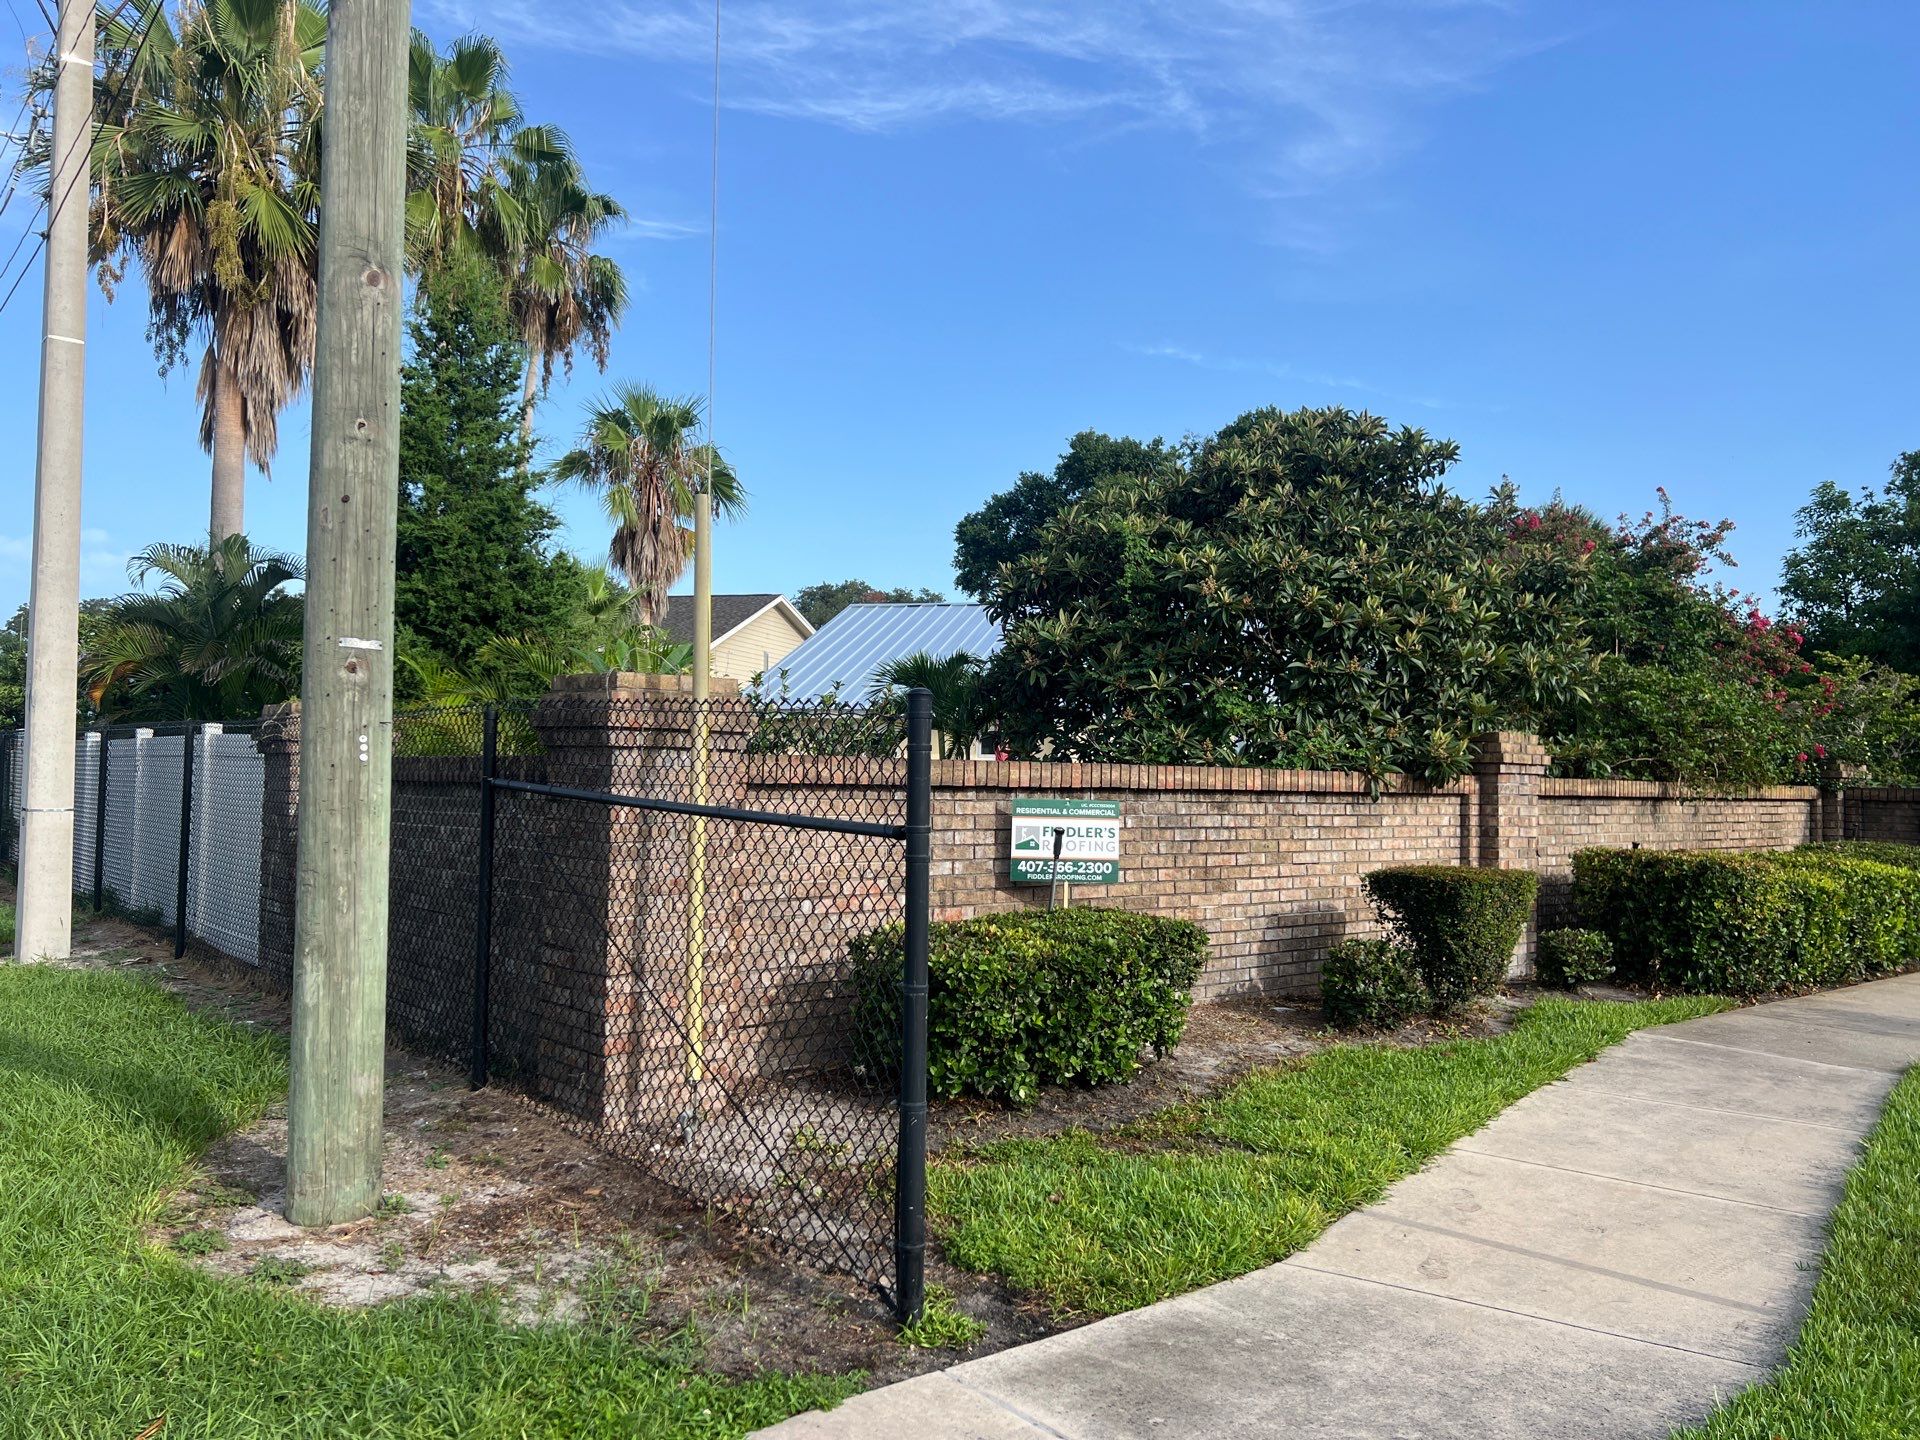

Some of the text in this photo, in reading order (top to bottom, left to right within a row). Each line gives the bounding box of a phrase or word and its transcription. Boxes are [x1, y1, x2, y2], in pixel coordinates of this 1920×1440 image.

[1016, 807, 1061, 815] RESIDENTIAL
[1069, 808, 1116, 816] COMMERCIAL
[1042, 826, 1116, 839] FIDLER'S
[1042, 840, 1116, 852] ROFING
[1017, 861, 1113, 874] 407-366-2300
